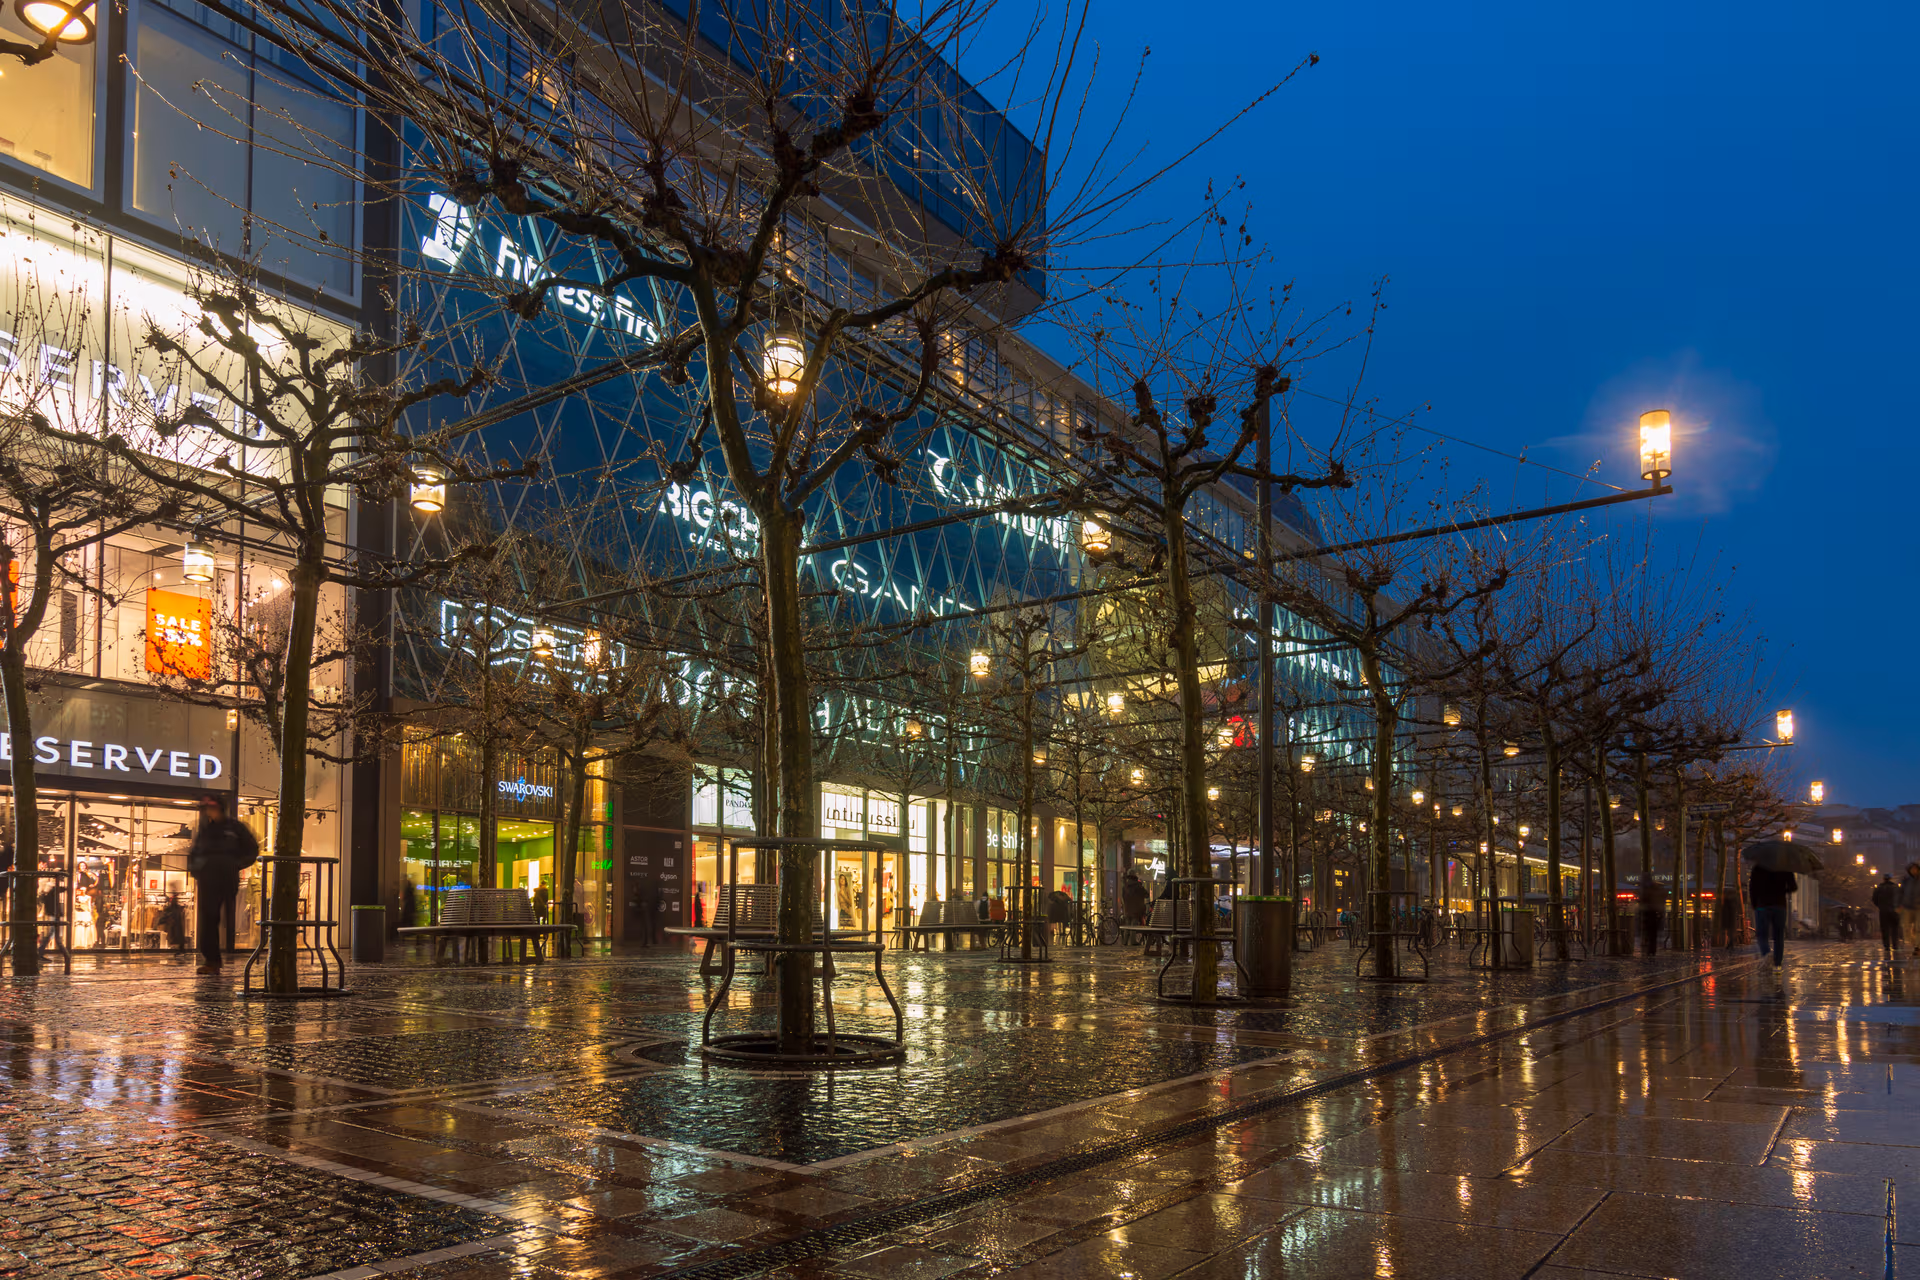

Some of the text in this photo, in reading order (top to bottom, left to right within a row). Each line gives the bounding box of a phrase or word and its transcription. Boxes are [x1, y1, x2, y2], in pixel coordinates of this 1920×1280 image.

[495, 236, 664, 346] Fitess Firs
[155, 614, 201, 631] SALE
[498, 780, 553, 797] SWAROVSKI
[726, 799, 752, 808] PANDO
[660, 871, 678, 881] dyson
